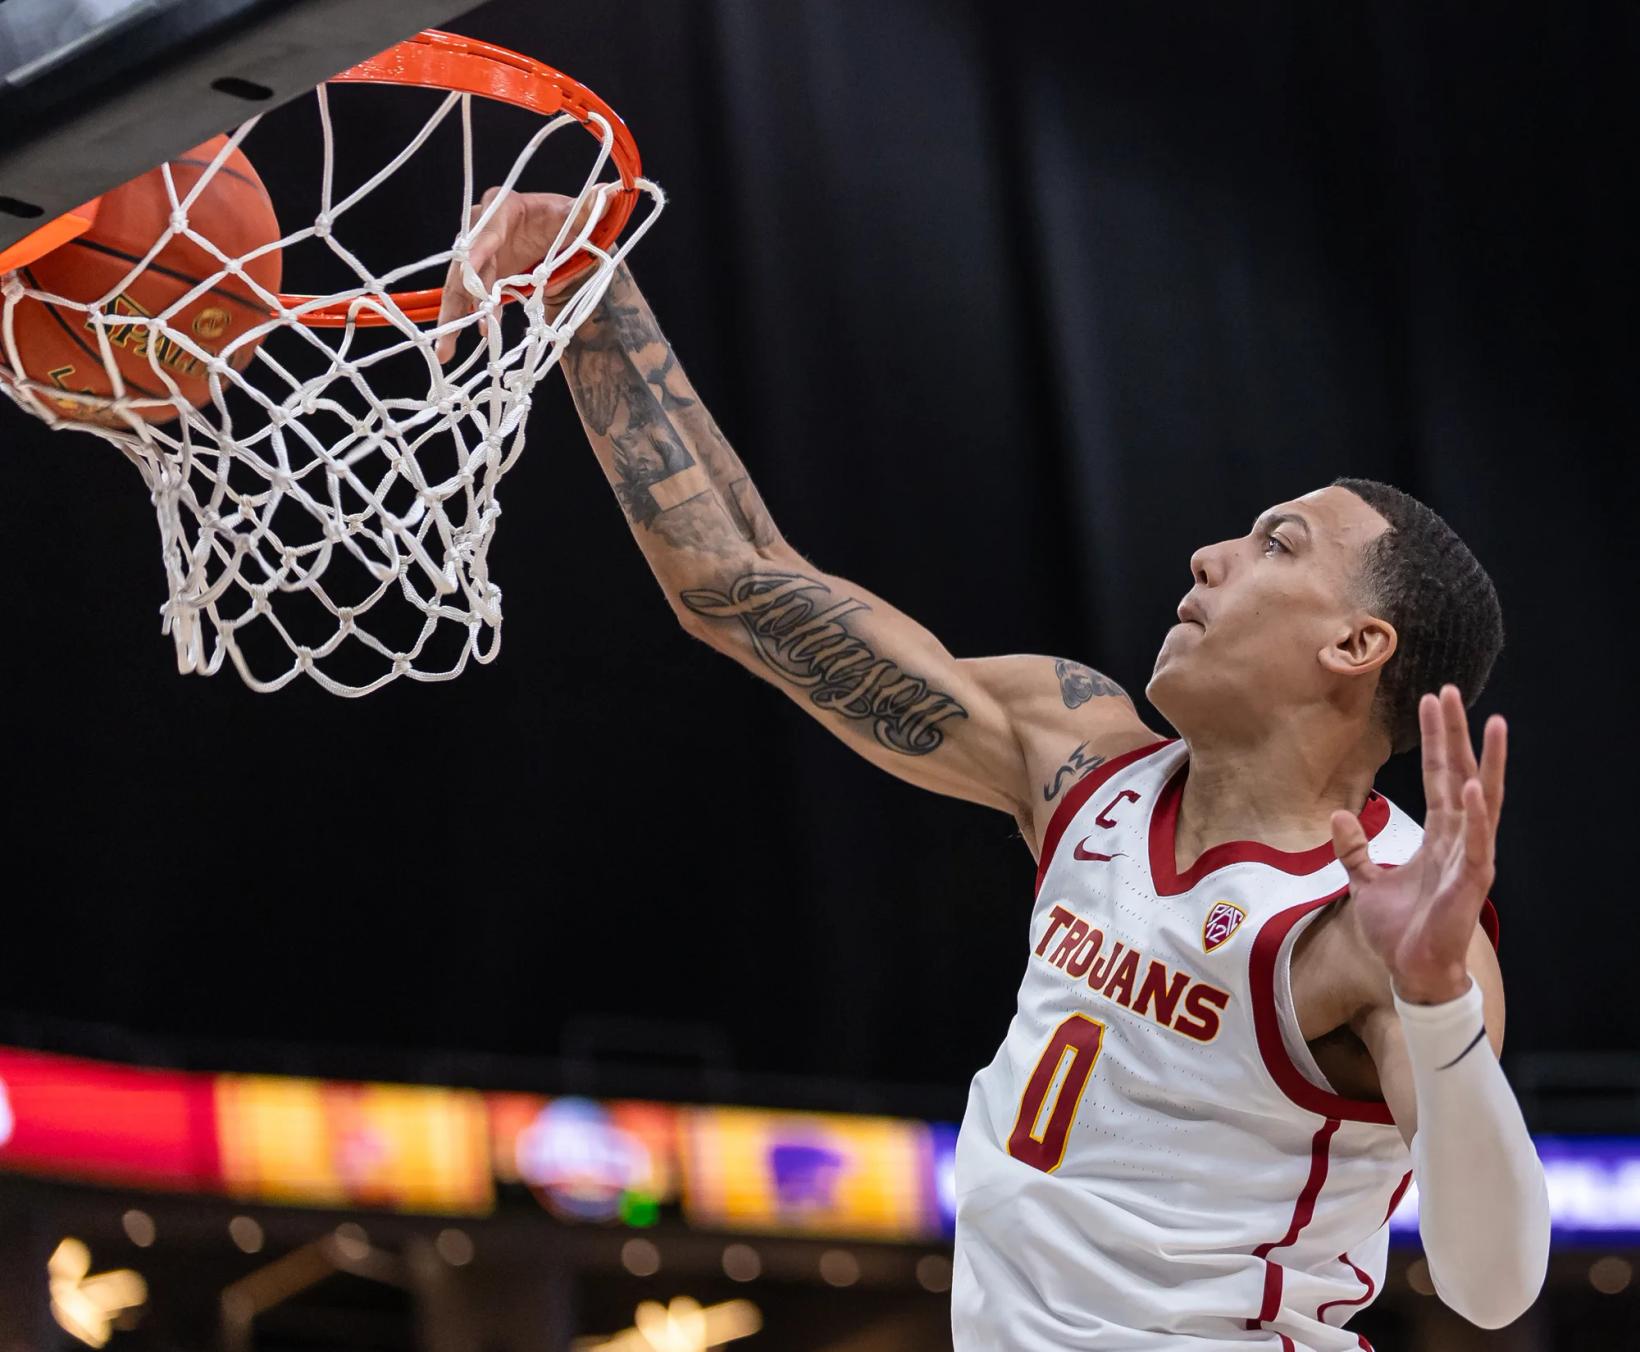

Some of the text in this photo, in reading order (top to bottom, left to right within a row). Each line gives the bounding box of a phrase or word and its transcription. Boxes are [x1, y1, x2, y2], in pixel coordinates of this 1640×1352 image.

[681, 573, 967, 755] Johnson
[1095, 790, 1141, 829] C
[1034, 905, 1229, 1044] TROJANS
[1206, 922, 1227, 943] 12
[1006, 1012, 1105, 1174] 0
